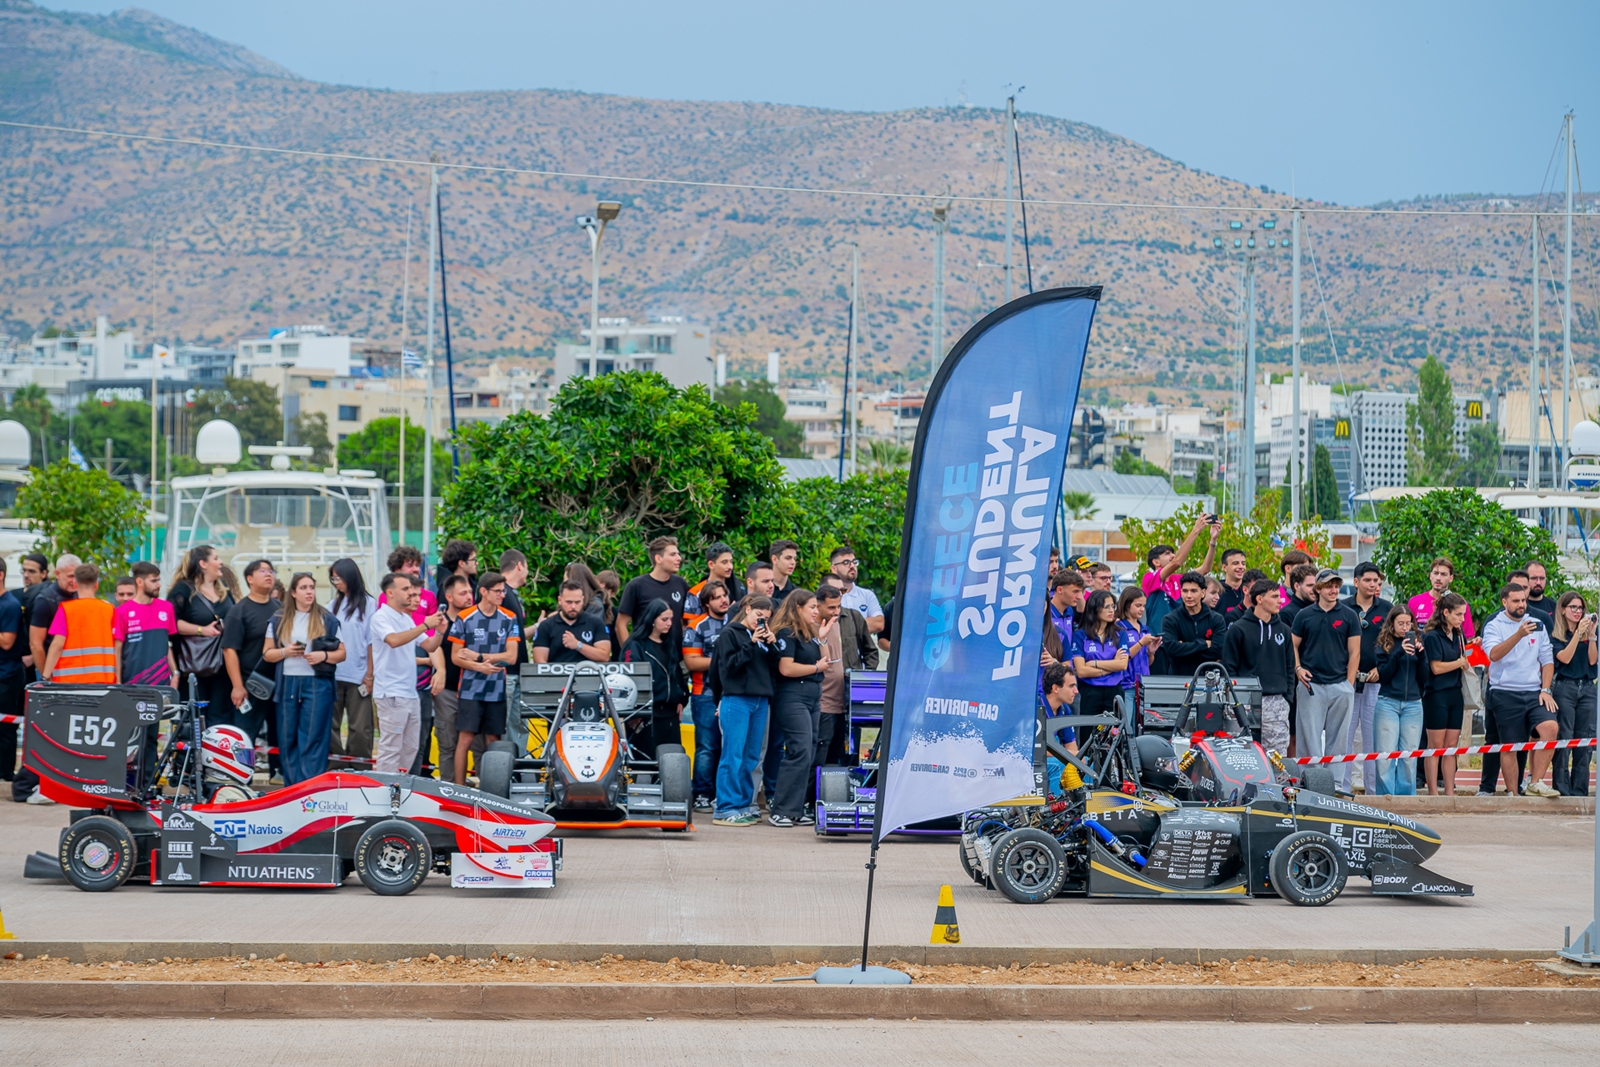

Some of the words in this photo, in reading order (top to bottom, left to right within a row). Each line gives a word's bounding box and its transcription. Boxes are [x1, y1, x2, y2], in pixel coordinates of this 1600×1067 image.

[139, 713, 156, 721] ICCS
[68, 714, 117, 748] E52
[318, 800, 348, 811] Global
[470, 794, 522, 813] PAPADOPOULOS
[1090, 809, 1138, 821] BETA
[1318, 796, 1416, 830] UniTHESSALONIKI
[248, 824, 283, 835] Navios
[492, 828, 527, 838] AIRTECH
[1383, 876, 1408, 884] BODY
